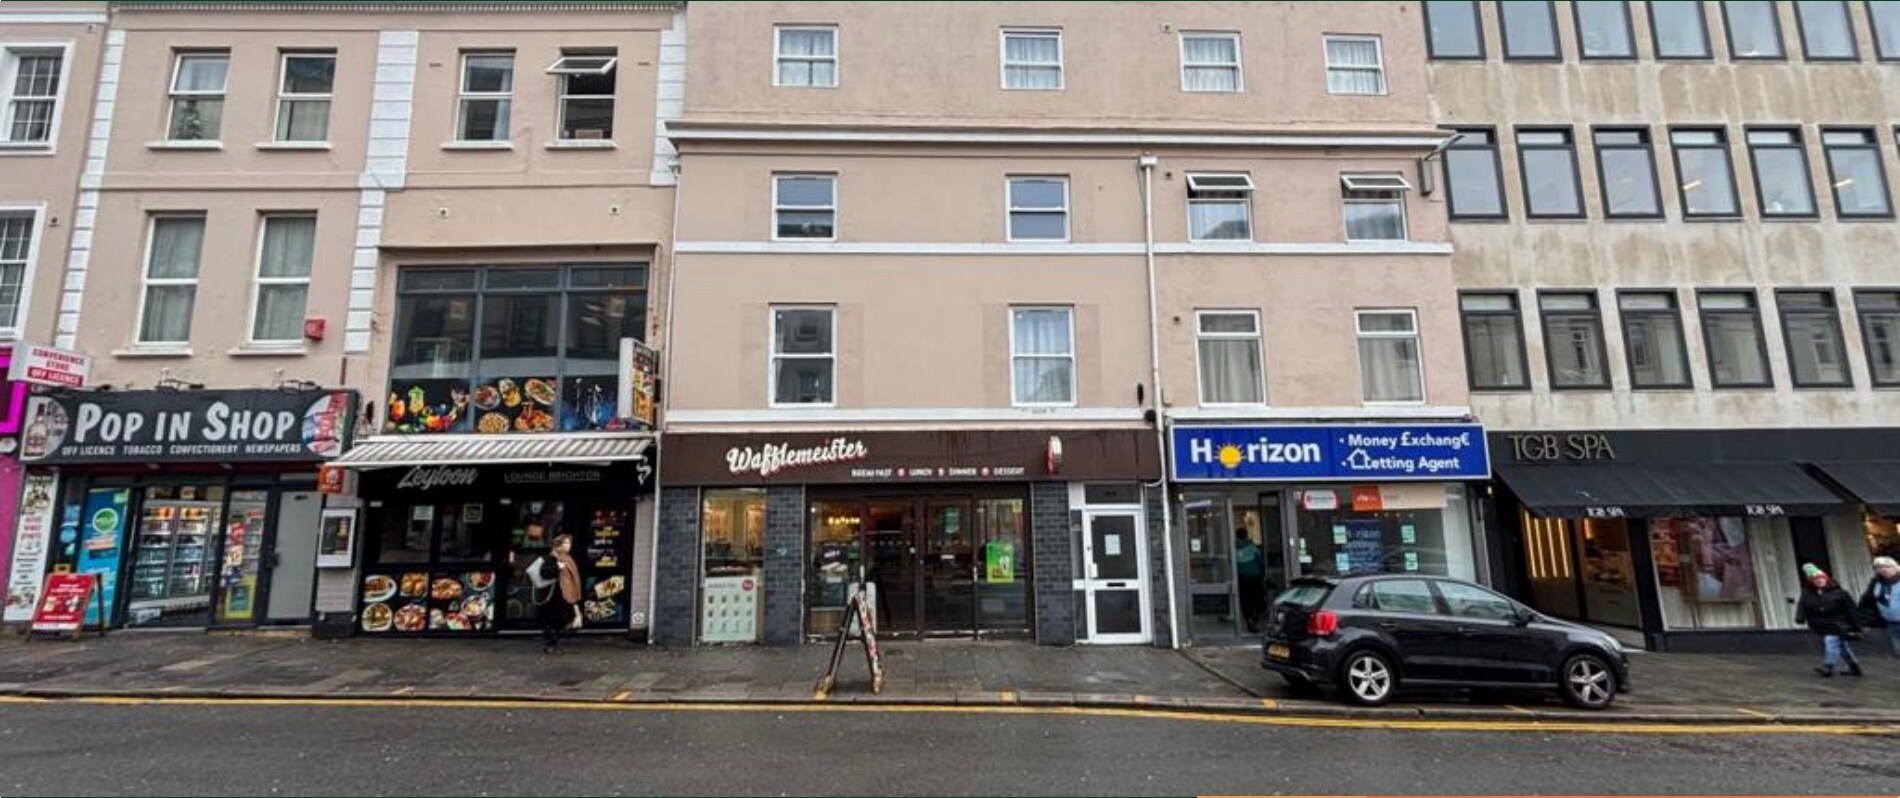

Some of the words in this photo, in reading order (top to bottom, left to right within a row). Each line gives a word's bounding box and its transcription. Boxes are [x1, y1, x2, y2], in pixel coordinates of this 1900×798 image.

[32, 348, 85, 366] CONVENIENCE
[45, 361, 70, 371] STORE
[30, 369, 47, 379] OFF
[47, 372, 80, 385] LICENCE
[74, 402, 144, 443] POP
[202, 401, 295, 441] SHOP
[61, 445, 78, 456] OFF
[80, 445, 116, 456] LICENCE
[123, 444, 162, 456] TOBACCO
[169, 444, 238, 455] CONFECTIONERY
[245, 443, 301, 454] NEWSPAPERS
[1348, 434, 1398, 450] Money
[1508, 434, 1560, 460] TGB
[1565, 434, 1616, 460] SPA
[725, 437, 867, 476] Wafflemeister
[1364, 456, 1415, 473] Letting
[1418, 456, 1460, 473] Agent
[909, 468, 932, 476] LUNCH
[949, 467, 977, 476] DINNER
[993, 467, 1025, 476] DESSERT
